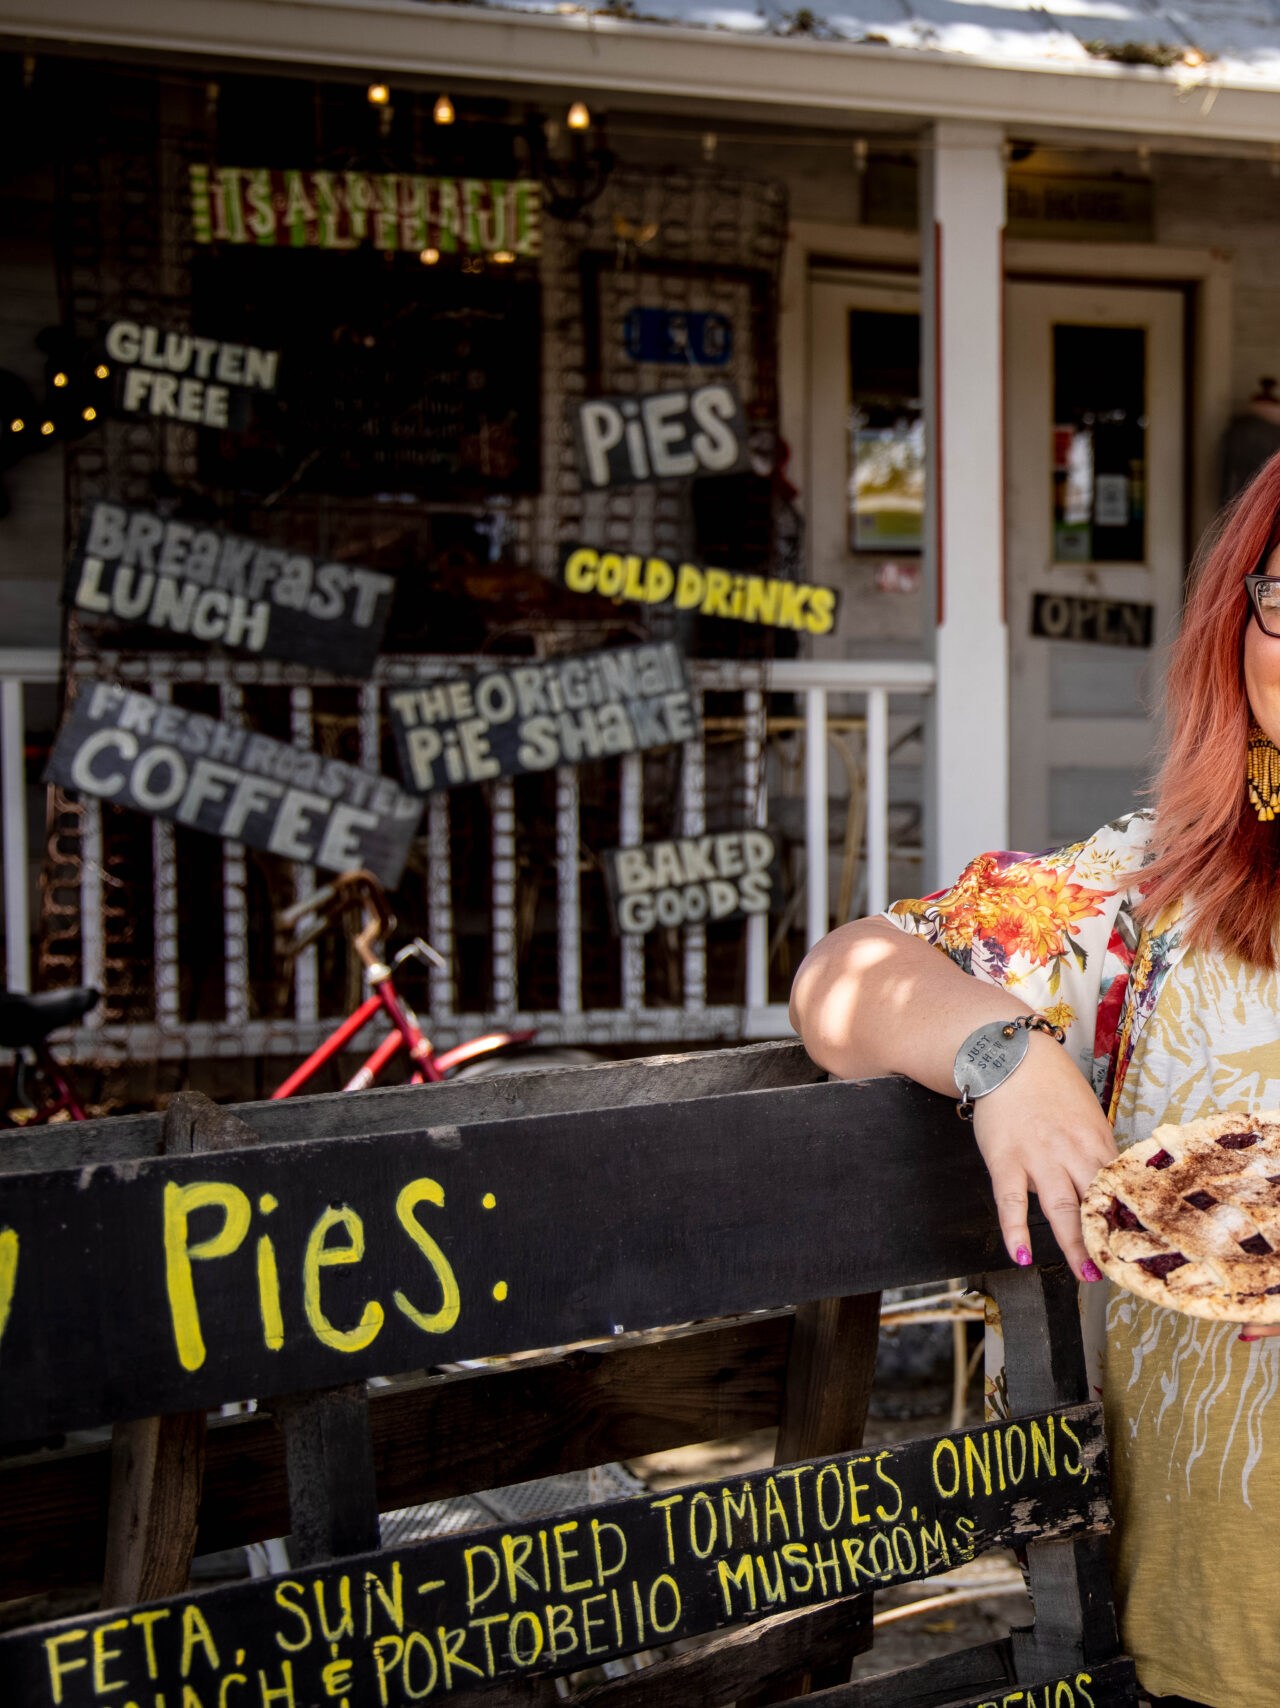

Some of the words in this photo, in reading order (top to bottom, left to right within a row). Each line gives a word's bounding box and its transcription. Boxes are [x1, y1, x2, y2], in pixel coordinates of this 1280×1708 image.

[105, 320, 279, 390] GLUTEN
[123, 367, 230, 430] FREE
[76, 556, 271, 652] LUNCH
[564, 547, 674, 604] COLD
[1038, 597, 1150, 646] OPEN
[88, 680, 250, 762] FRESH
[392, 680, 474, 727] THE
[71, 727, 380, 874] COFFEE
[614, 829, 775, 894] BAKED
[618, 870, 773, 934] GOODS
[967, 1034, 991, 1063] JUST
[992, 1053, 1007, 1069] UP
[44, 1605, 246, 1705] FETA,
[650, 1449, 919, 1566] TOMATOES,
[932, 1414, 1090, 1500] ONIONS,
[716, 1515, 976, 1617] MUSHROOMS
